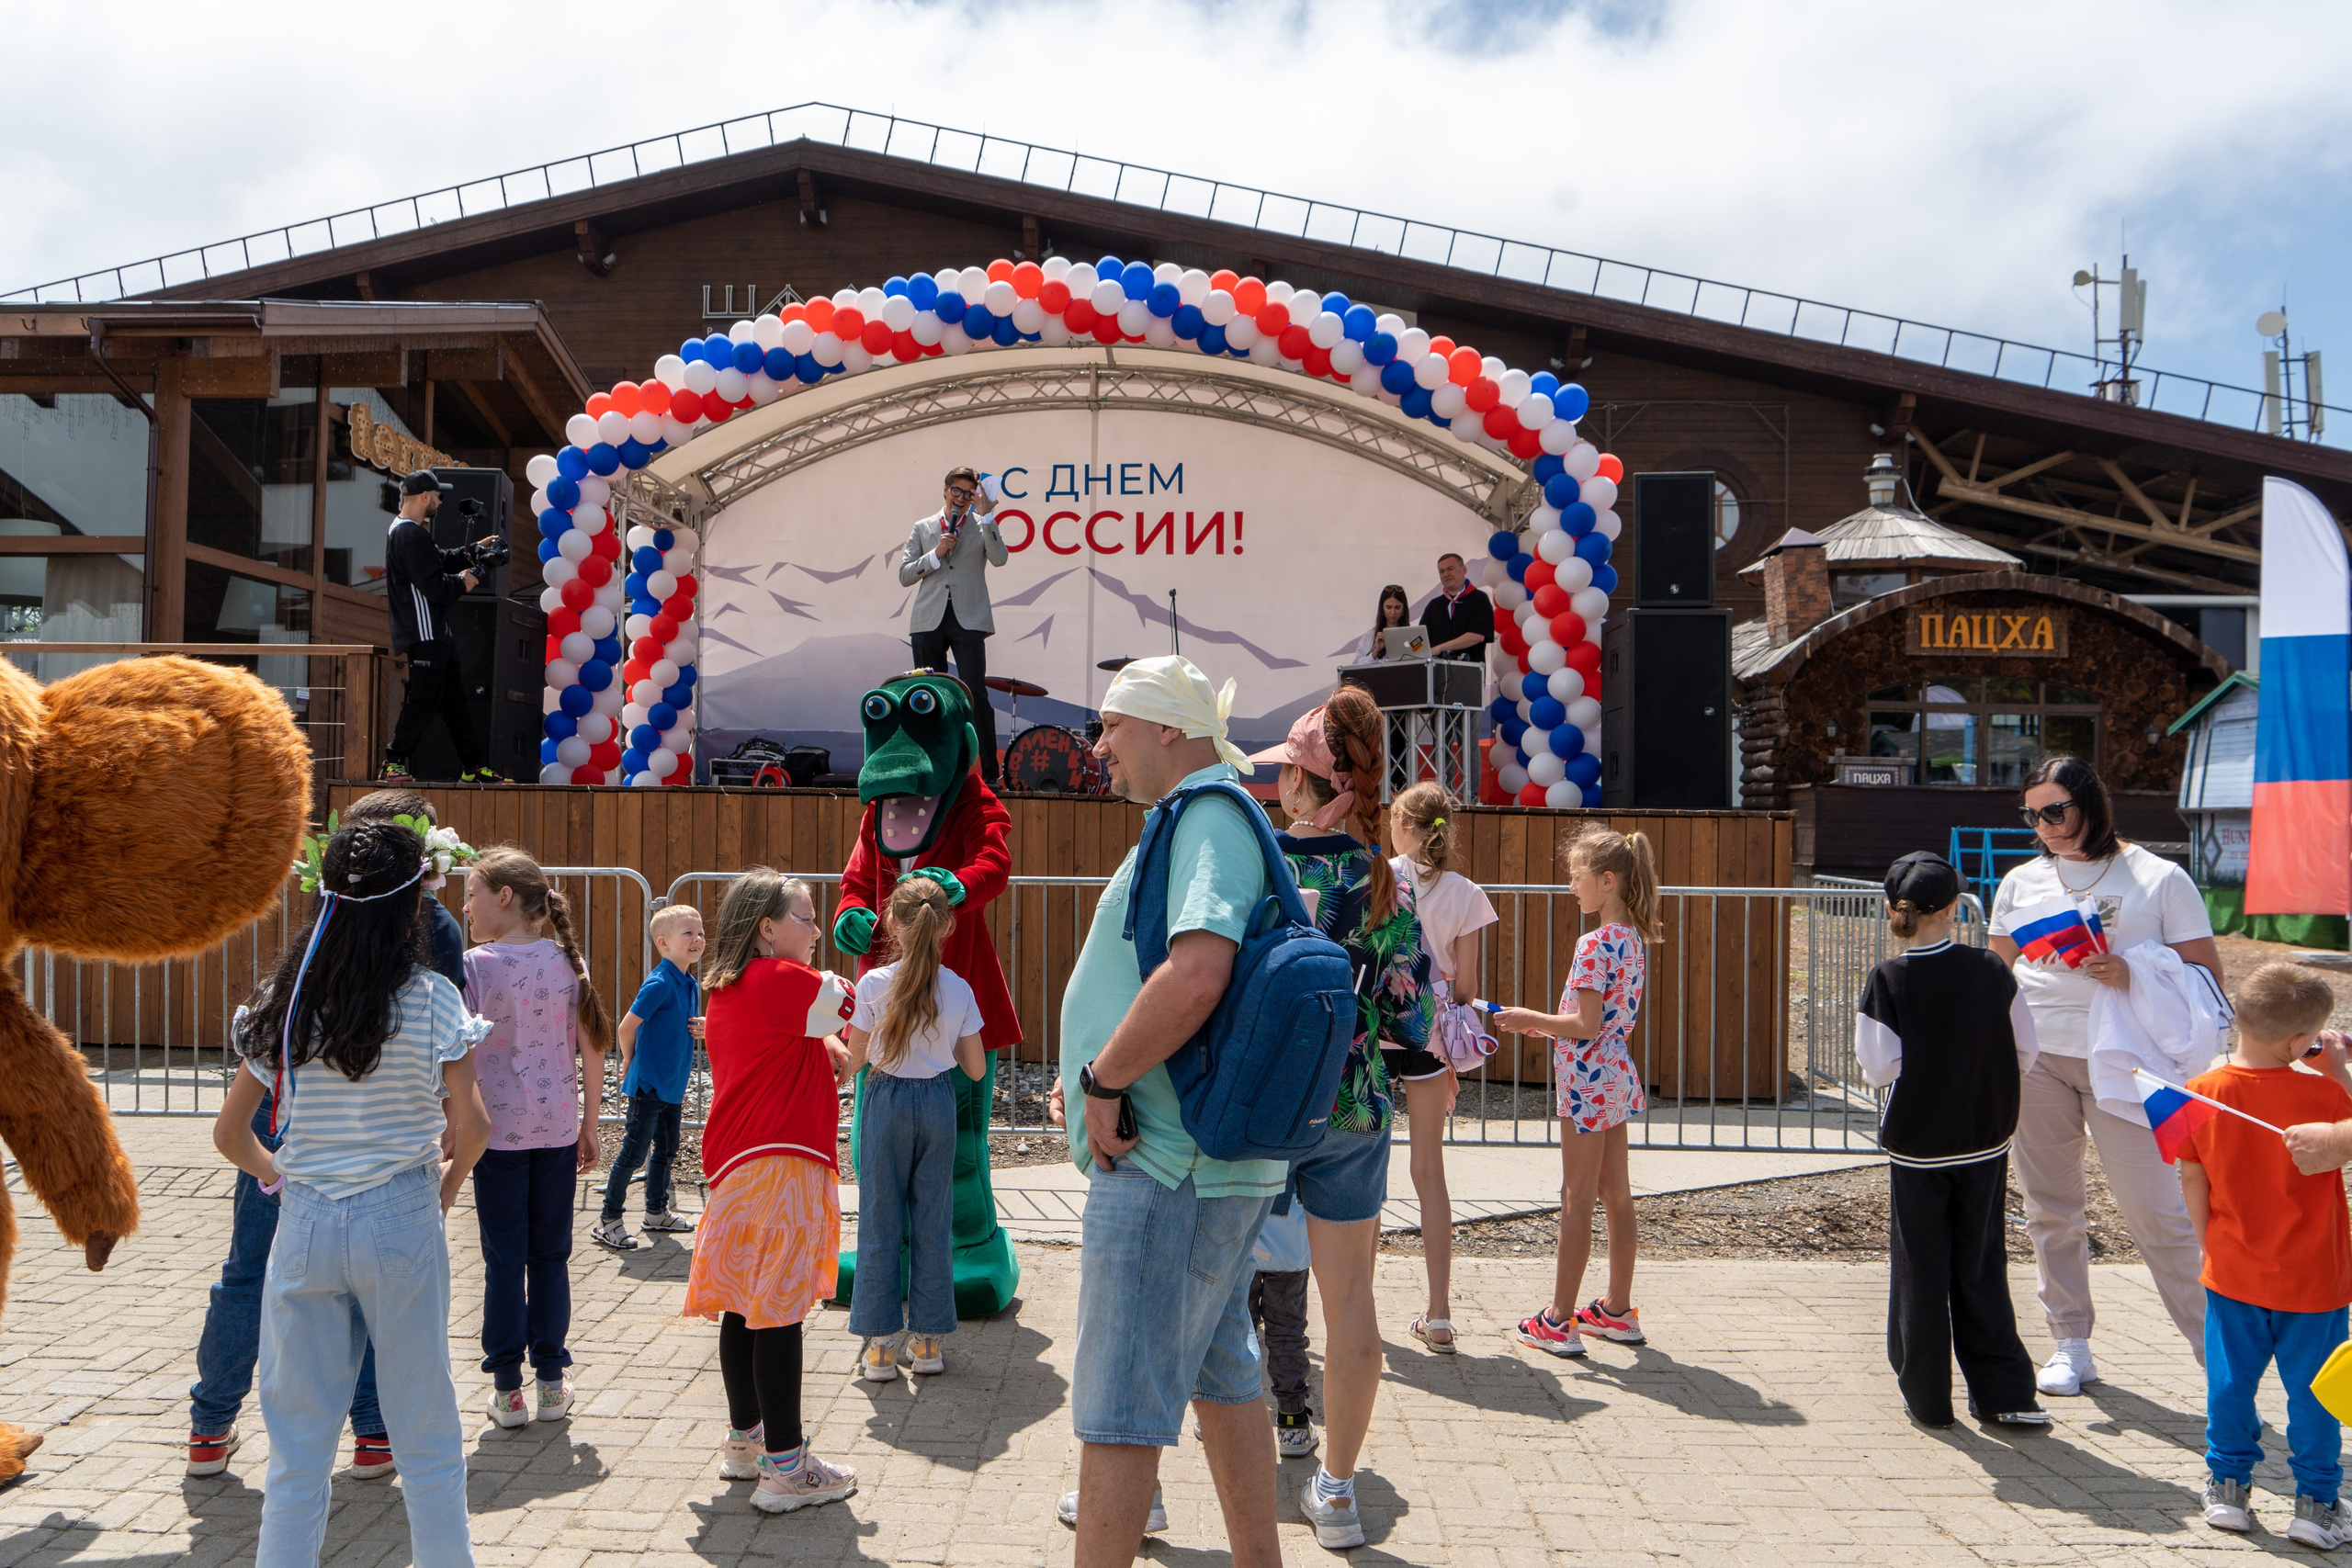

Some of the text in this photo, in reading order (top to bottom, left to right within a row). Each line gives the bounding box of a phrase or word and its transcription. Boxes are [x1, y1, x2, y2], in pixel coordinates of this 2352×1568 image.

[702, 284, 808, 319] ША
[348, 401, 470, 479] terra
[1001, 462, 1183, 502] С ДНЕМ
[993, 509, 1244, 556] ОССИИ!
[1919, 614, 2054, 653] ПАЦХА
[1853, 773, 1892, 785] ПАЦХА
